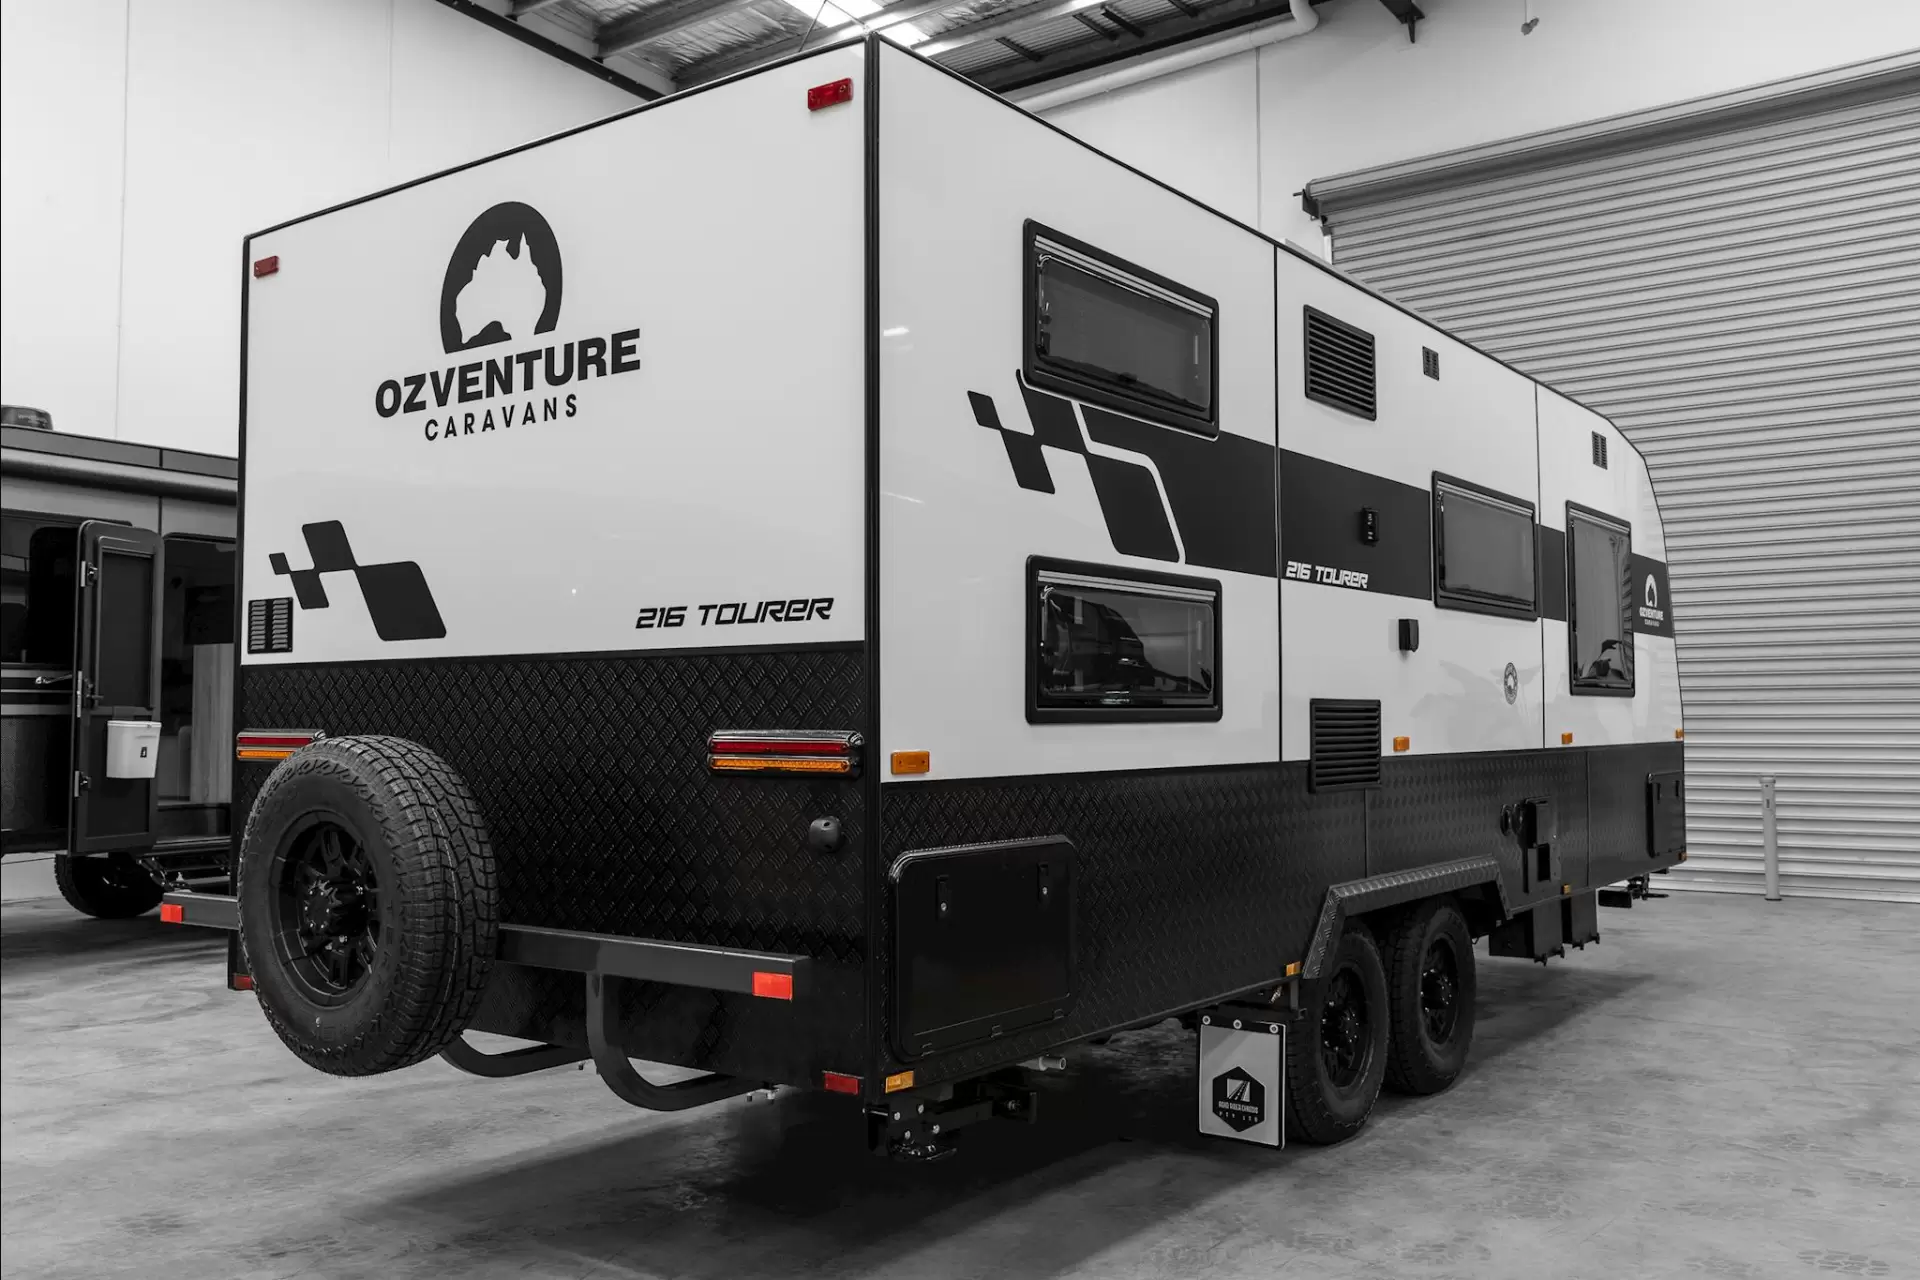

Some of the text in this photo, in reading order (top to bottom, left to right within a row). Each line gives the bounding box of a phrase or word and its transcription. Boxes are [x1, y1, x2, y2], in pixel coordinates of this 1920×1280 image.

[375, 328, 641, 418] OZVENTURE
[424, 393, 577, 441] CARAVANS
[1285, 560, 1369, 589] 216 TOURER
[635, 597, 835, 629] 216 TOURER
[1639, 606, 1664, 621] OZVENTURE
